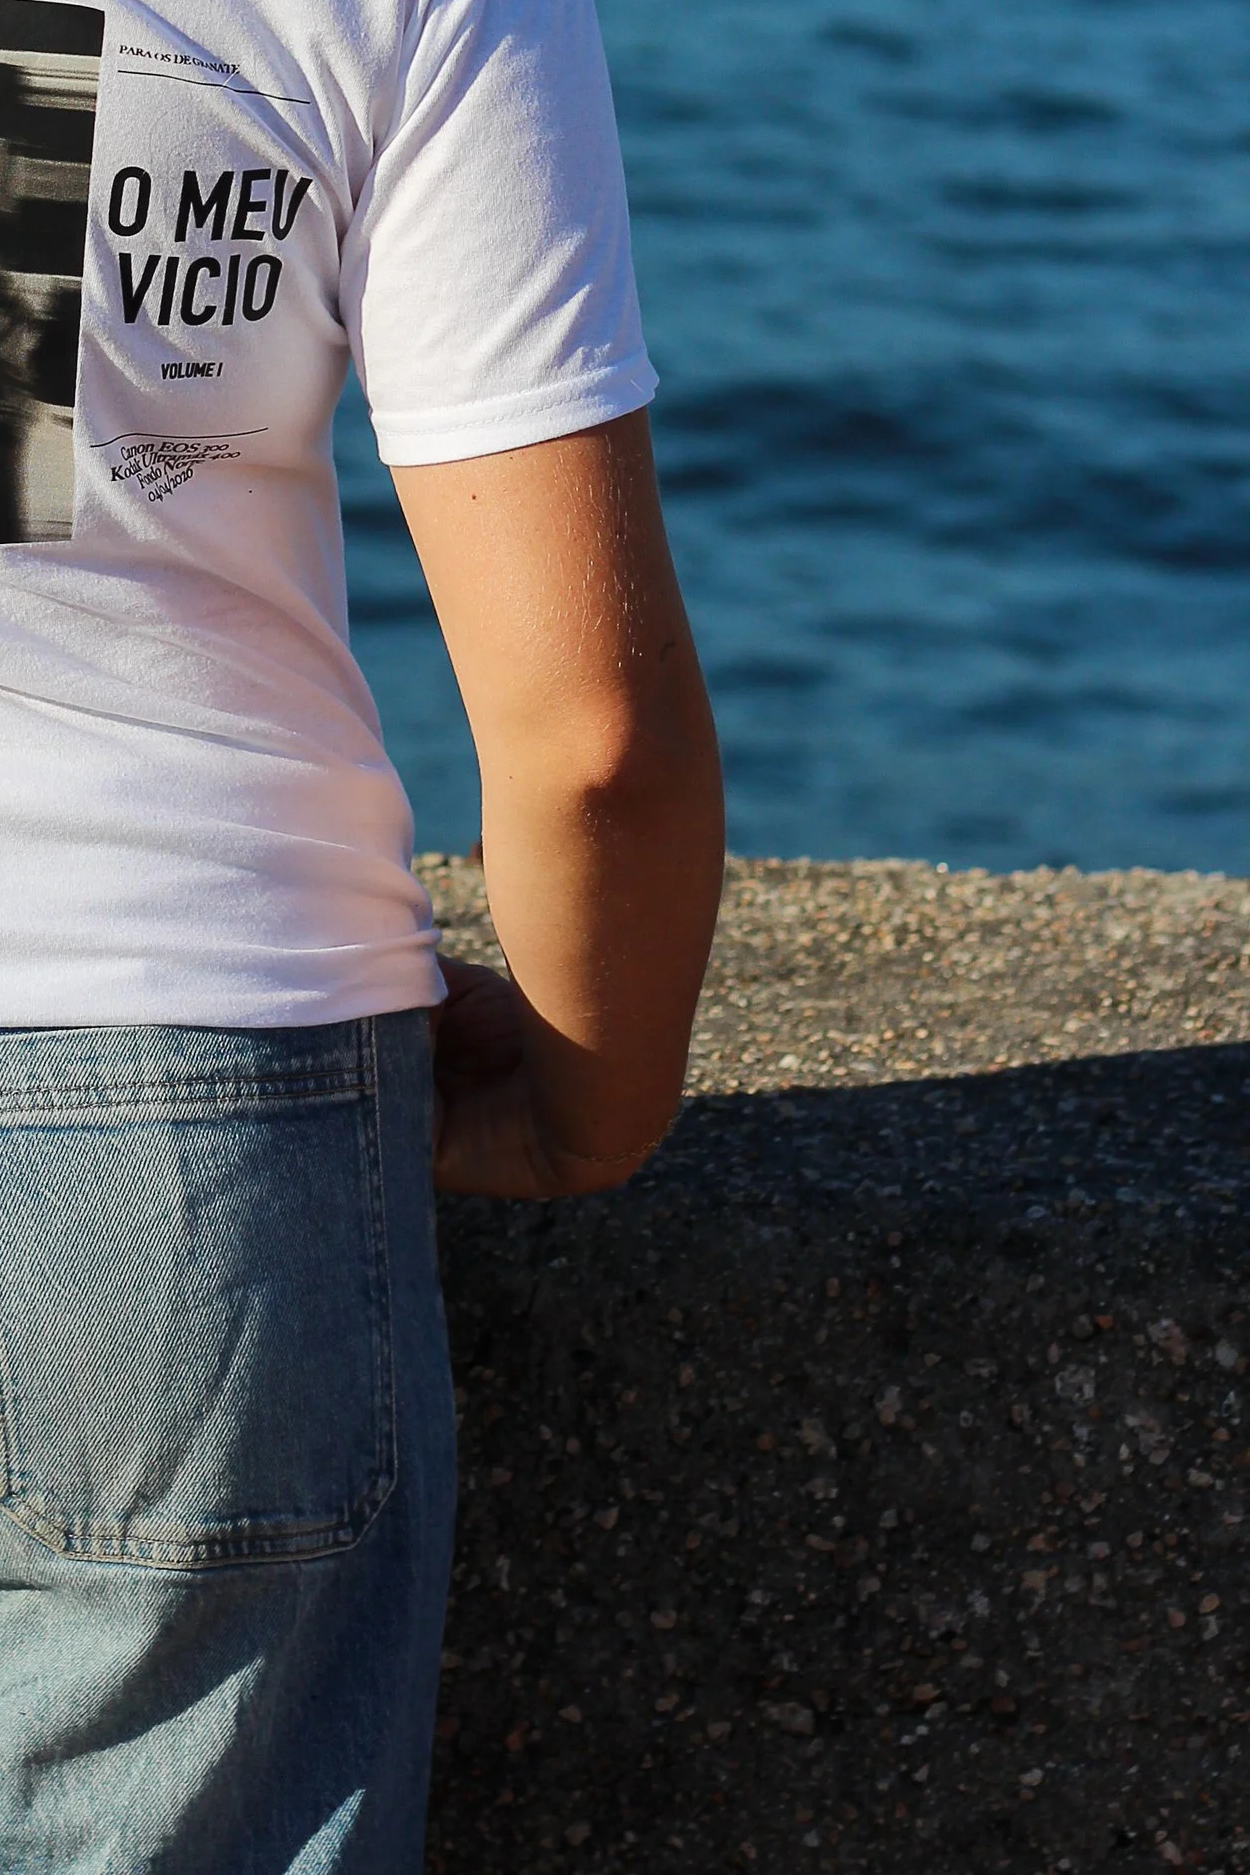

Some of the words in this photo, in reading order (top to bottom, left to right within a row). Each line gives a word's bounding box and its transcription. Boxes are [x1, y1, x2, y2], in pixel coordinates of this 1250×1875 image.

[119, 45, 153, 59] PARA
[174, 54, 192, 65] DE
[108, 166, 152, 237] O
[174, 168, 313, 243] MEU
[118, 252, 283, 326] VICIO
[161, 363, 217, 380] VOLUME
[120, 442, 155, 461] Canon
[158, 441, 202, 453] EOS
[111, 457, 143, 482] Kodak
